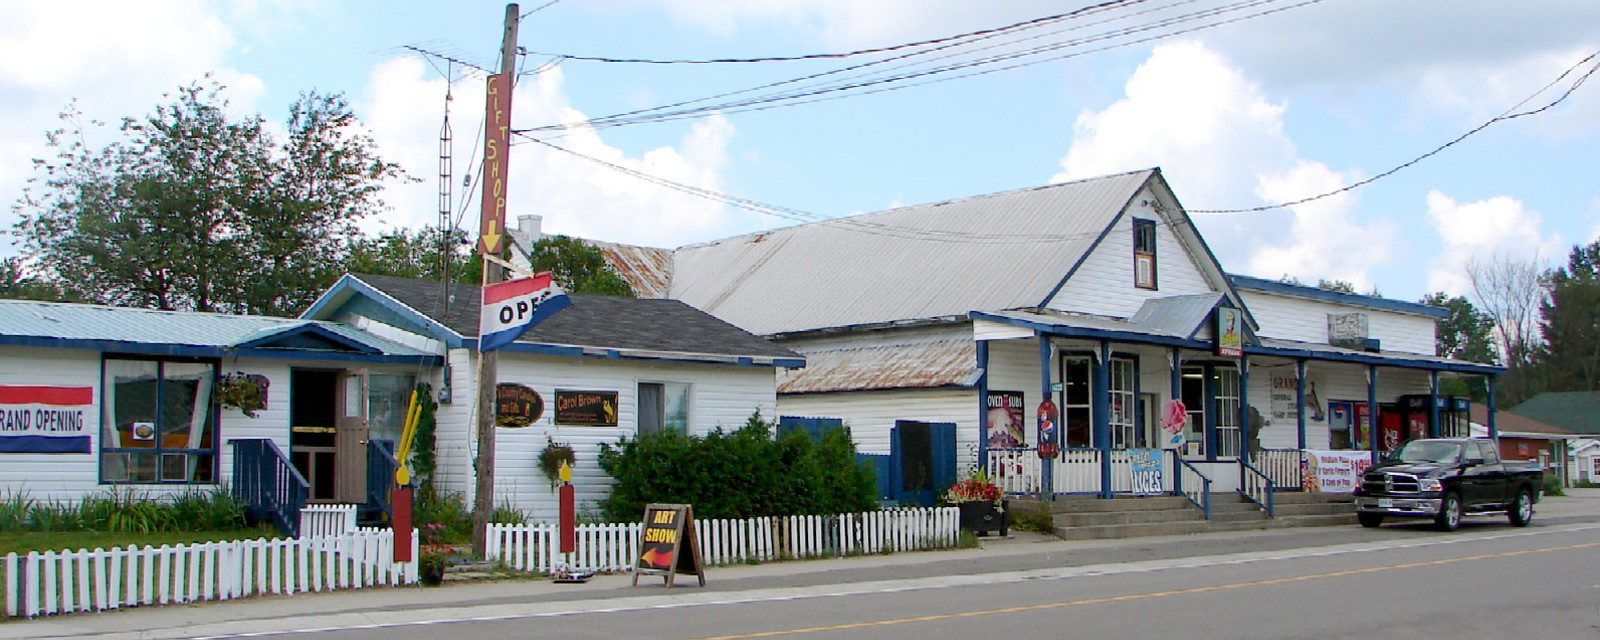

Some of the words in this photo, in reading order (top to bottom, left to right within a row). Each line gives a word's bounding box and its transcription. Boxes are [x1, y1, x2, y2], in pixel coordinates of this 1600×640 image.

[488, 78, 508, 140] GIFT
[487, 139, 505, 216] SHOP
[558, 394, 577, 411] Carol
[578, 394, 601, 407] Brown
[988, 394, 1003, 408] OVEN
[1008, 395, 1022, 408] SUBS
[36, 409, 83, 431] OPENING
[654, 511, 676, 524] ART
[645, 528, 677, 543] SHOW
